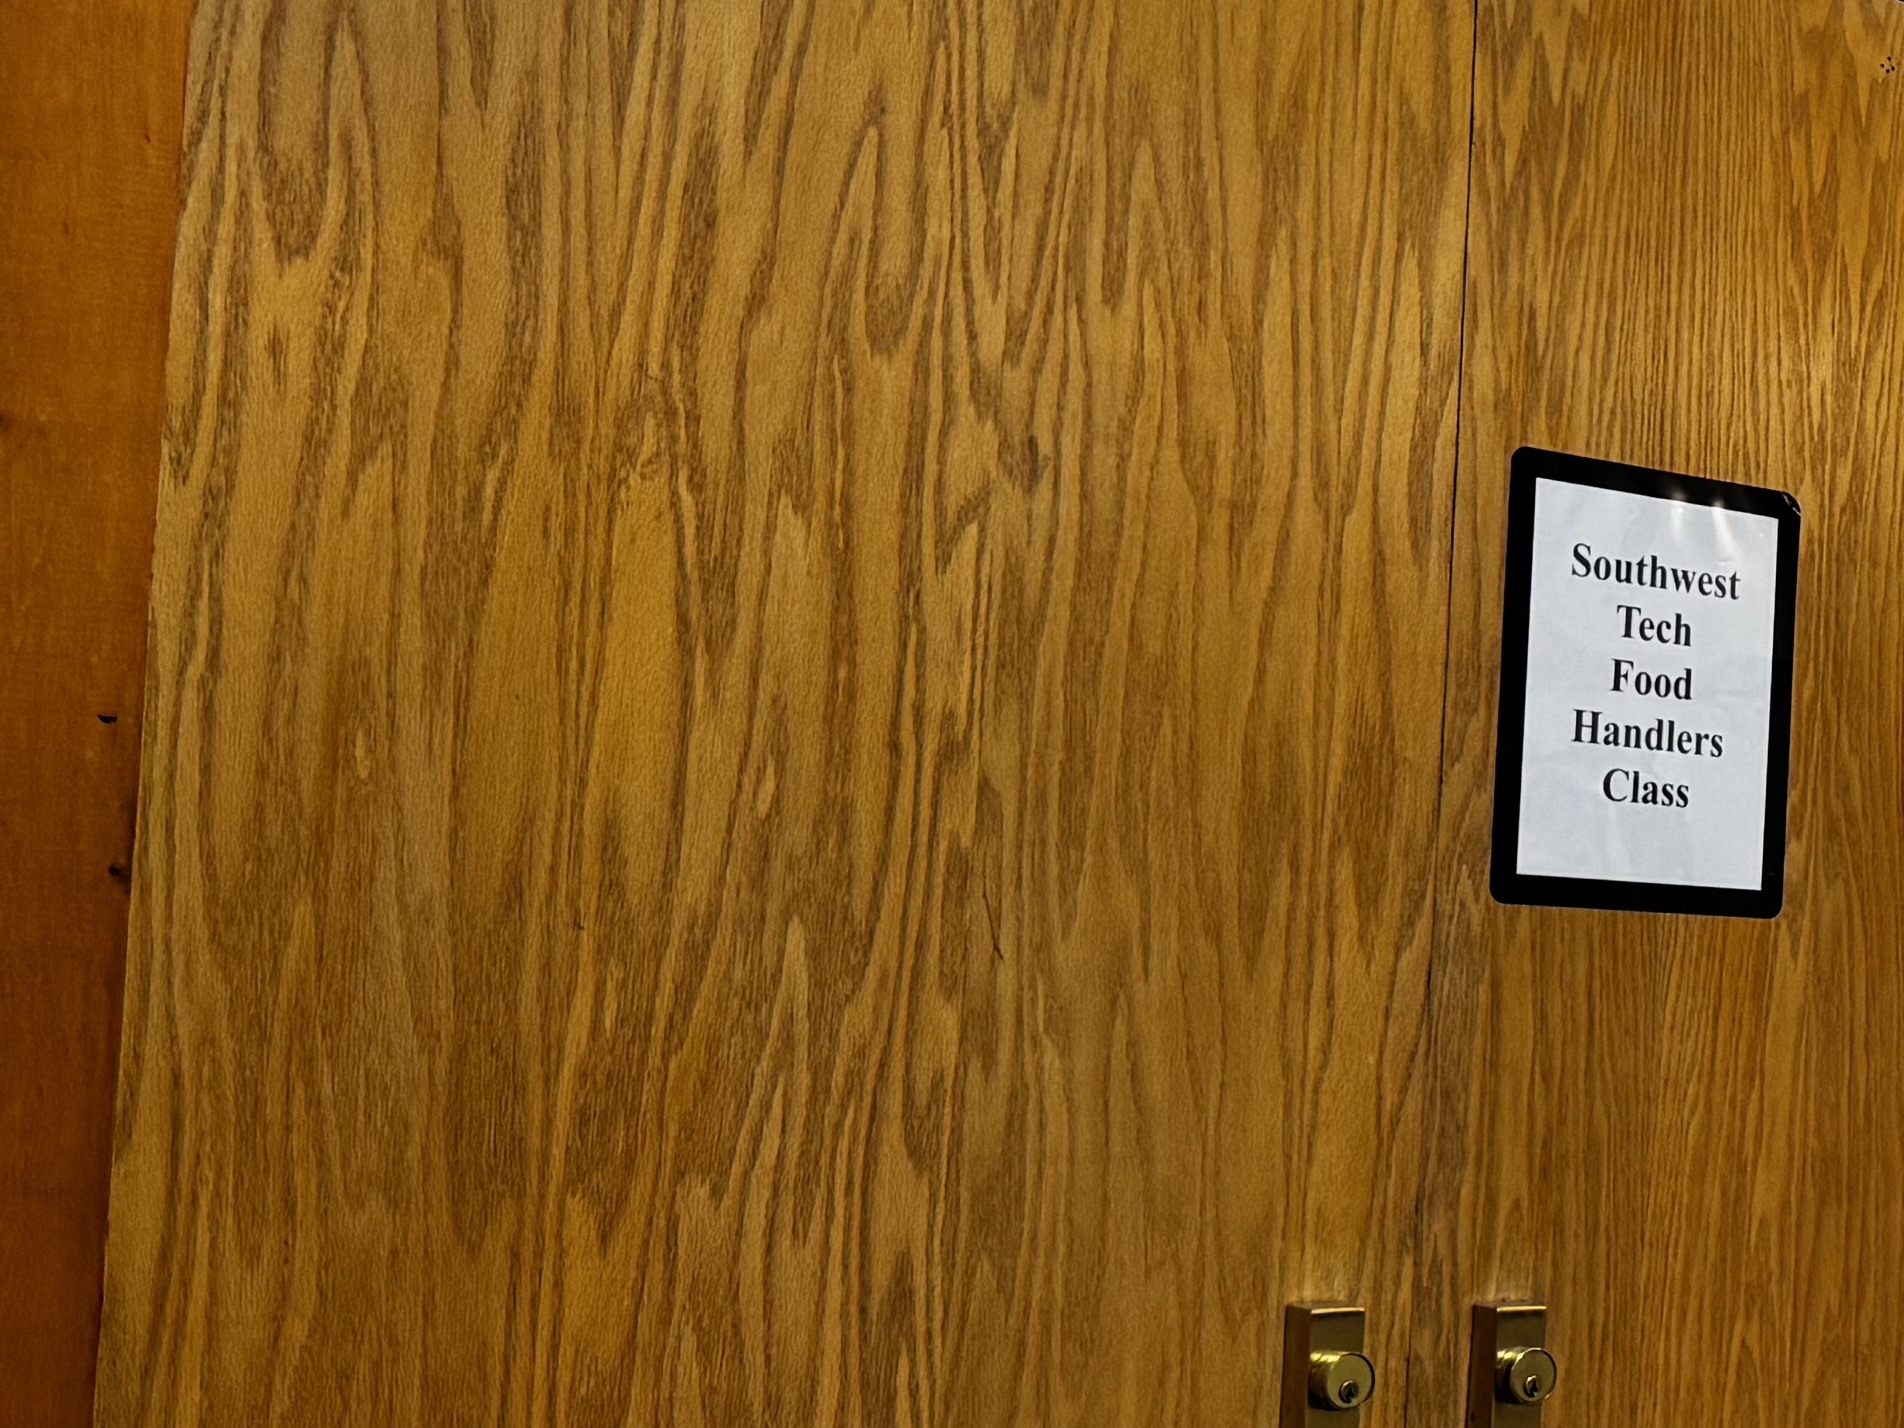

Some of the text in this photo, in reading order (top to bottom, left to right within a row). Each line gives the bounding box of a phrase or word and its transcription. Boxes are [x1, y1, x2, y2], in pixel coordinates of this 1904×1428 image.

[1571, 542, 1741, 601] Southwest
[1616, 604, 1693, 647] Tech
[1609, 658, 1693, 701] Food
[1571, 708, 1724, 758] Handlers
[1602, 767, 1690, 809] Class
